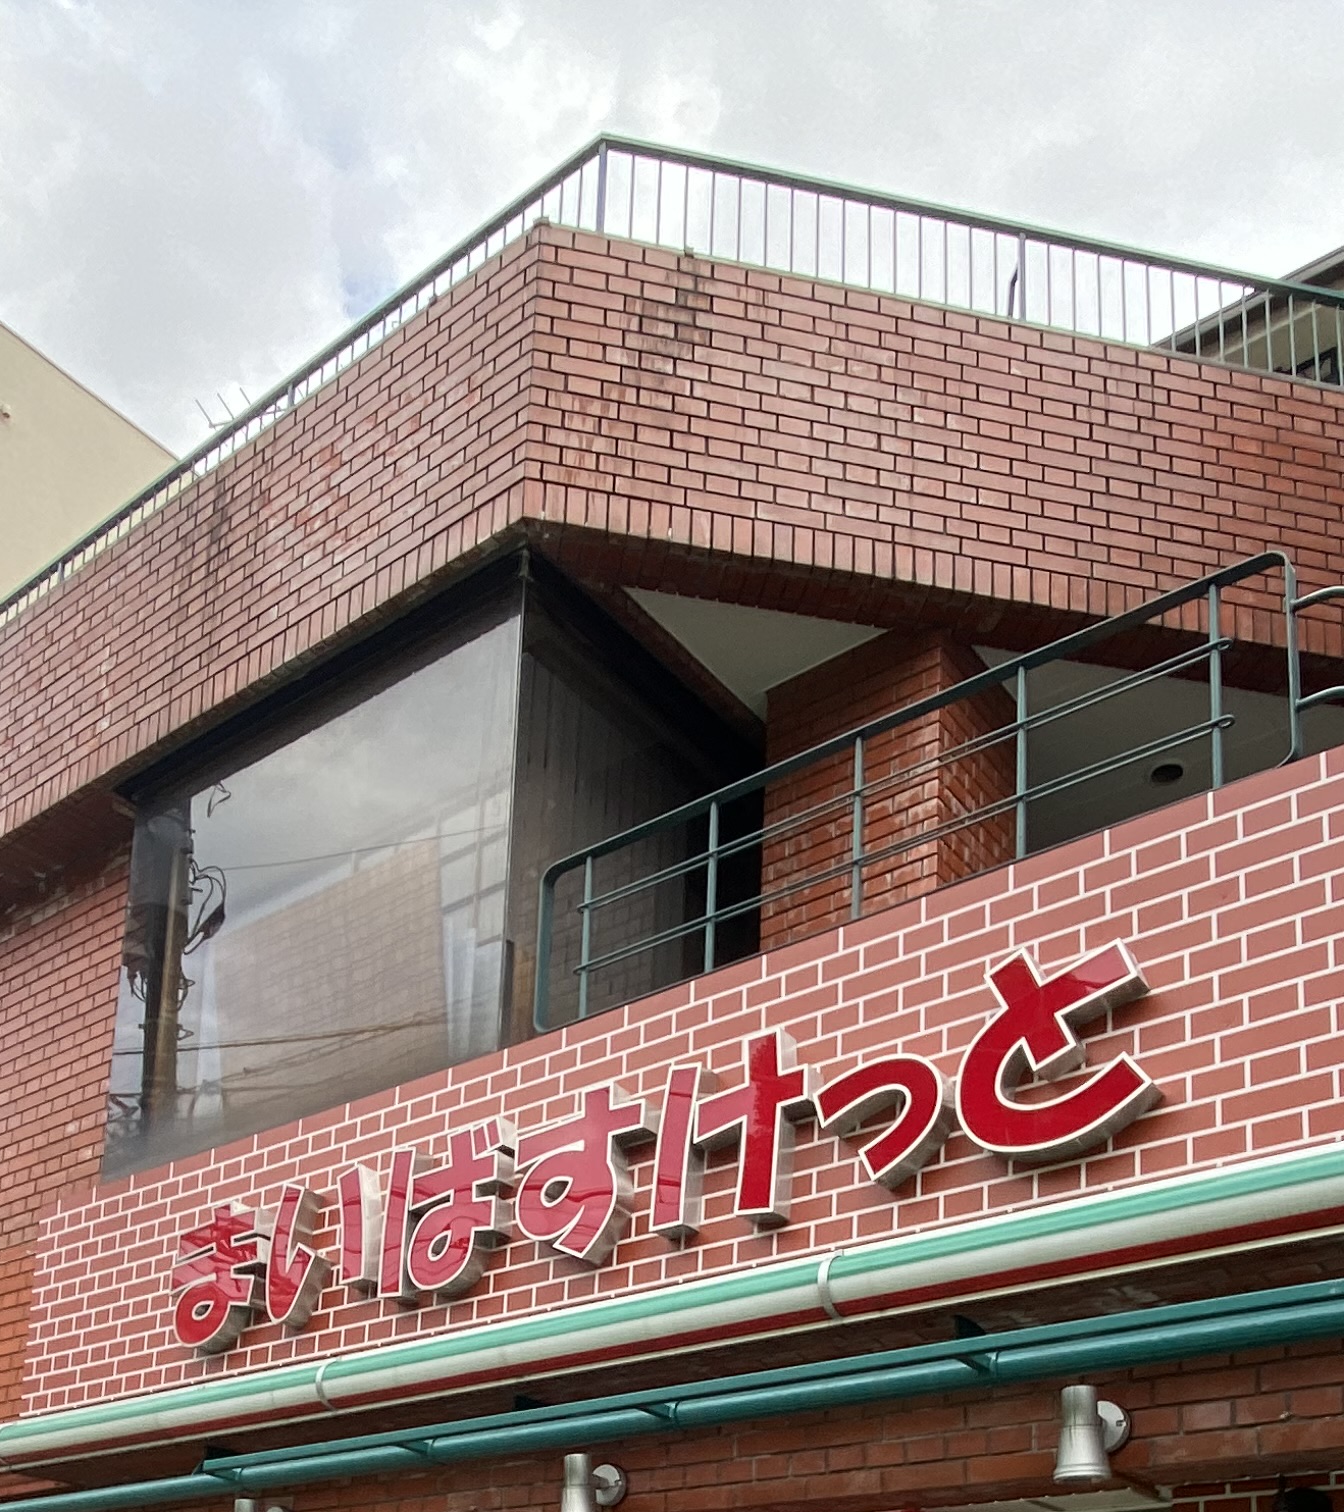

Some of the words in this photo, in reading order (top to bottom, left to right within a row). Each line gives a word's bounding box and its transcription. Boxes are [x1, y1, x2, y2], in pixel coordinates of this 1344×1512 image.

[173, 939, 1163, 1353] まいばすけっと
